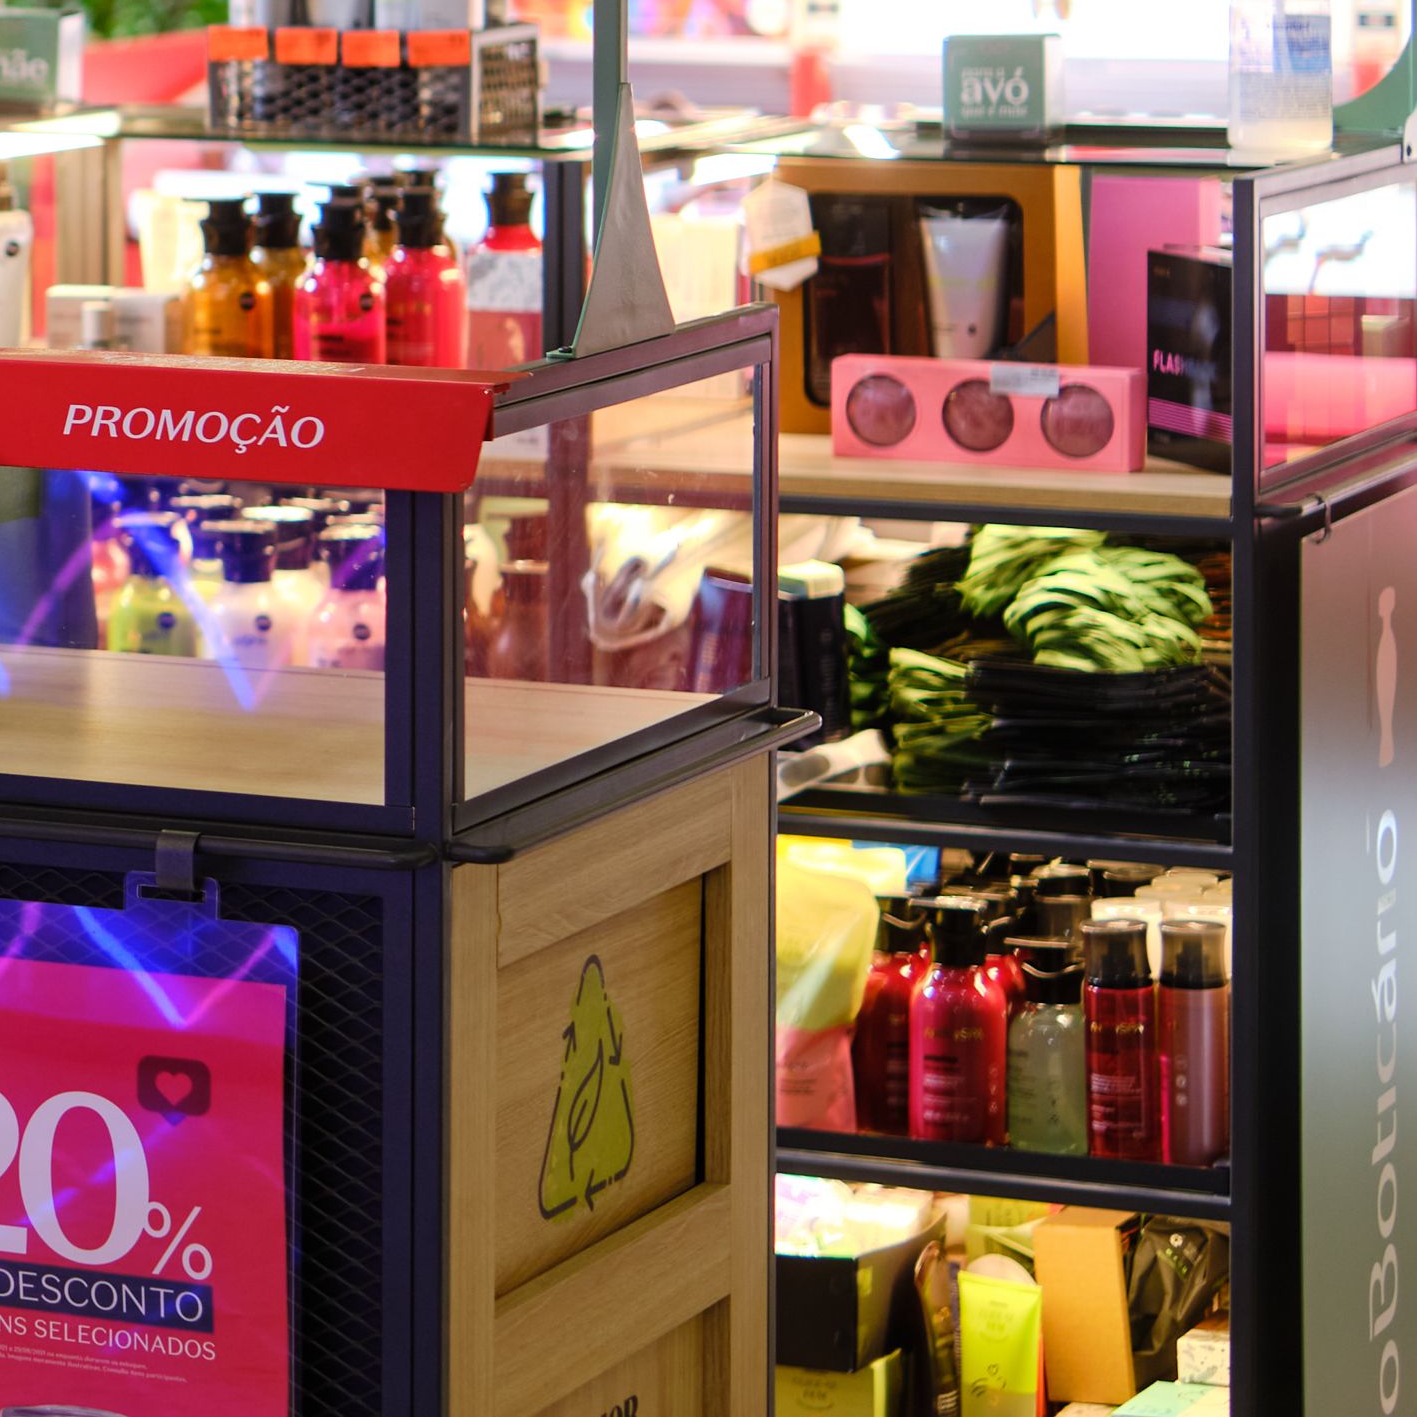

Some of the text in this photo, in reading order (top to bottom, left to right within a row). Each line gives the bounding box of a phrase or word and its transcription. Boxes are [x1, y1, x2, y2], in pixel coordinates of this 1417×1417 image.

[960, 67, 1029, 105] avó
[63, 404, 325, 454] PROMOÇÃO
[35, 1319, 216, 1361] SELECIONADOS
